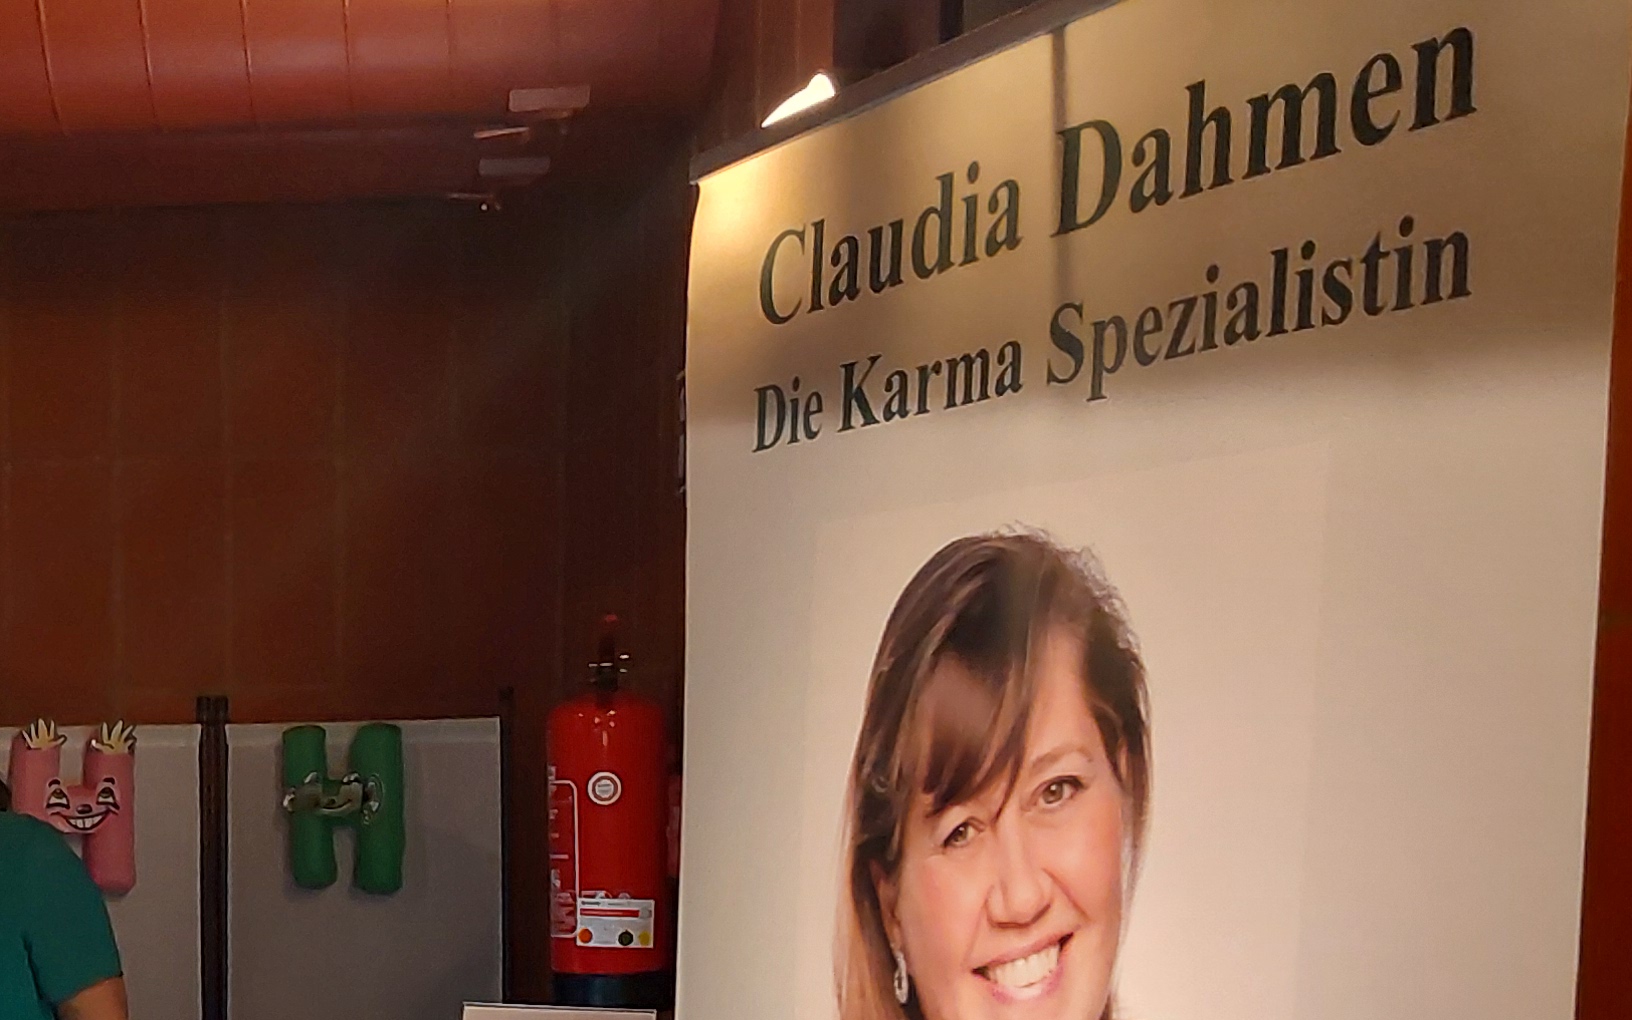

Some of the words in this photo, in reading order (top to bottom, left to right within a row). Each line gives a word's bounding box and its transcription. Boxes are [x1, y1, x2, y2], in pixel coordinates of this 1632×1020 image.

[757, 160, 1021, 326] Claudia
[1049, 25, 1478, 238] Dahmen
[751, 377, 822, 454] Die
[835, 339, 1022, 434] Karma
[1044, 214, 1473, 402] Spezialistin
